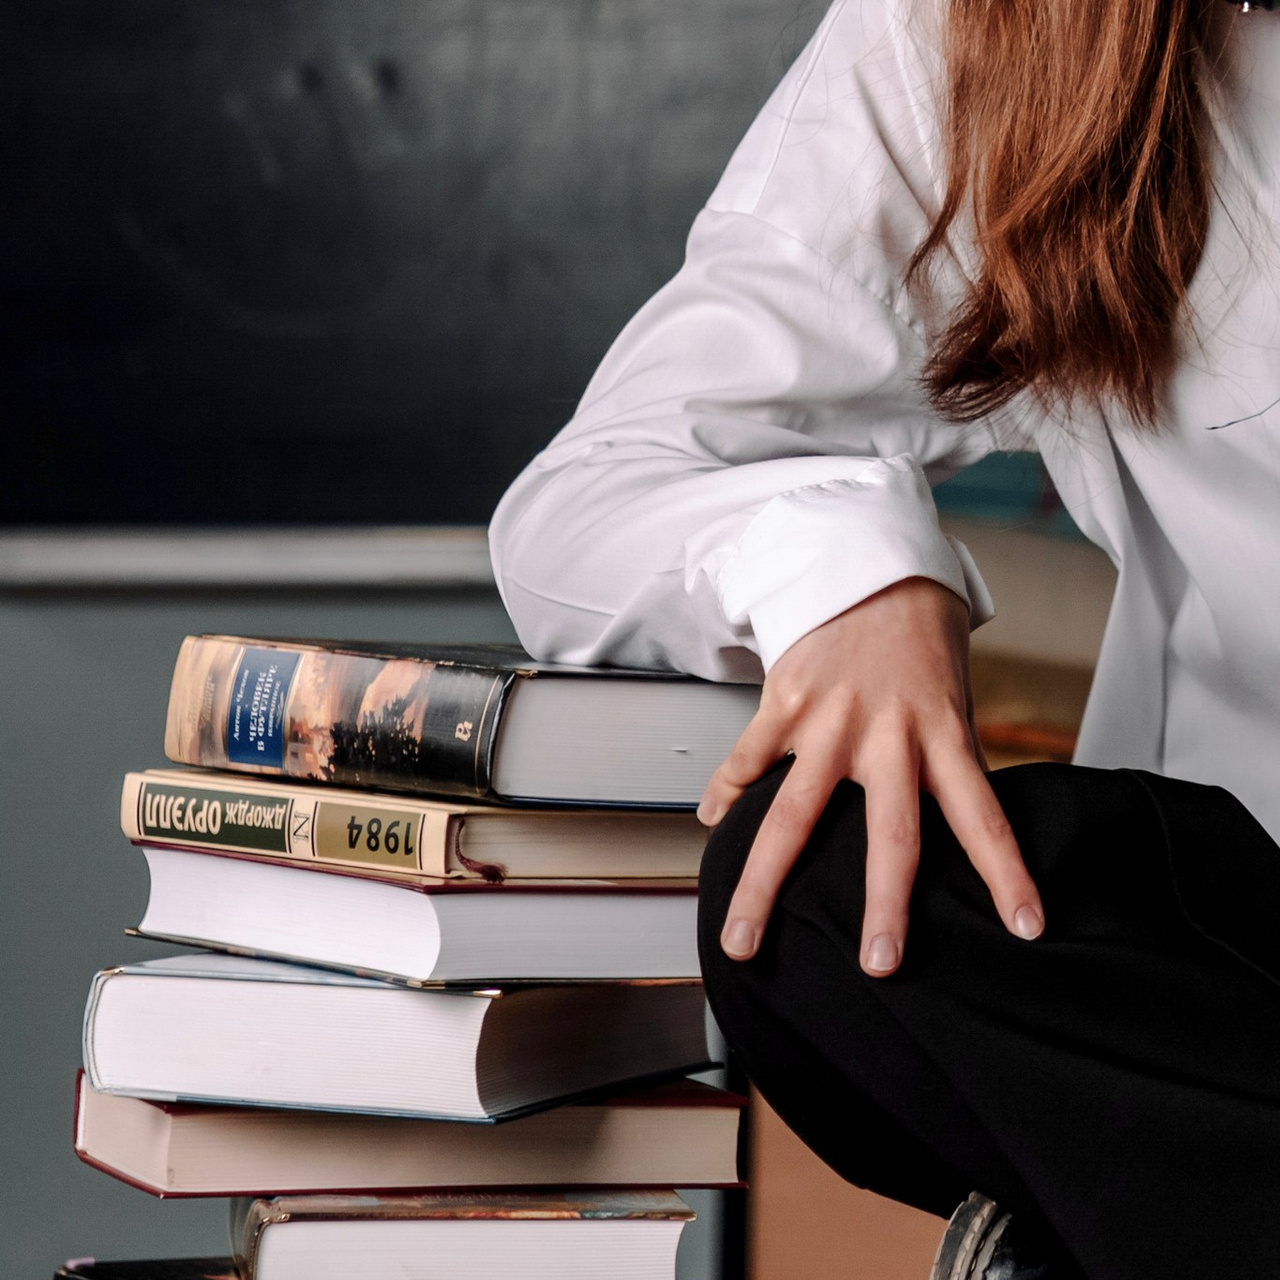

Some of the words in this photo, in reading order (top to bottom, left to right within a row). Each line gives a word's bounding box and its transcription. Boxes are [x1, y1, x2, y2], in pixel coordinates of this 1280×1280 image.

[233, 705, 241, 741] Антон
[237, 669, 249, 702] Чехов
[249, 672, 266, 741] ЧЕЛОВЕК
[257, 664, 277, 737] ФУТЛЯРЕ
[257, 741, 265, 751] В
[144, 792, 223, 835] ОРУЭЛЛ
[224, 799, 288, 831] ДЖОРДЖ
[347, 815, 414, 856] 1984
